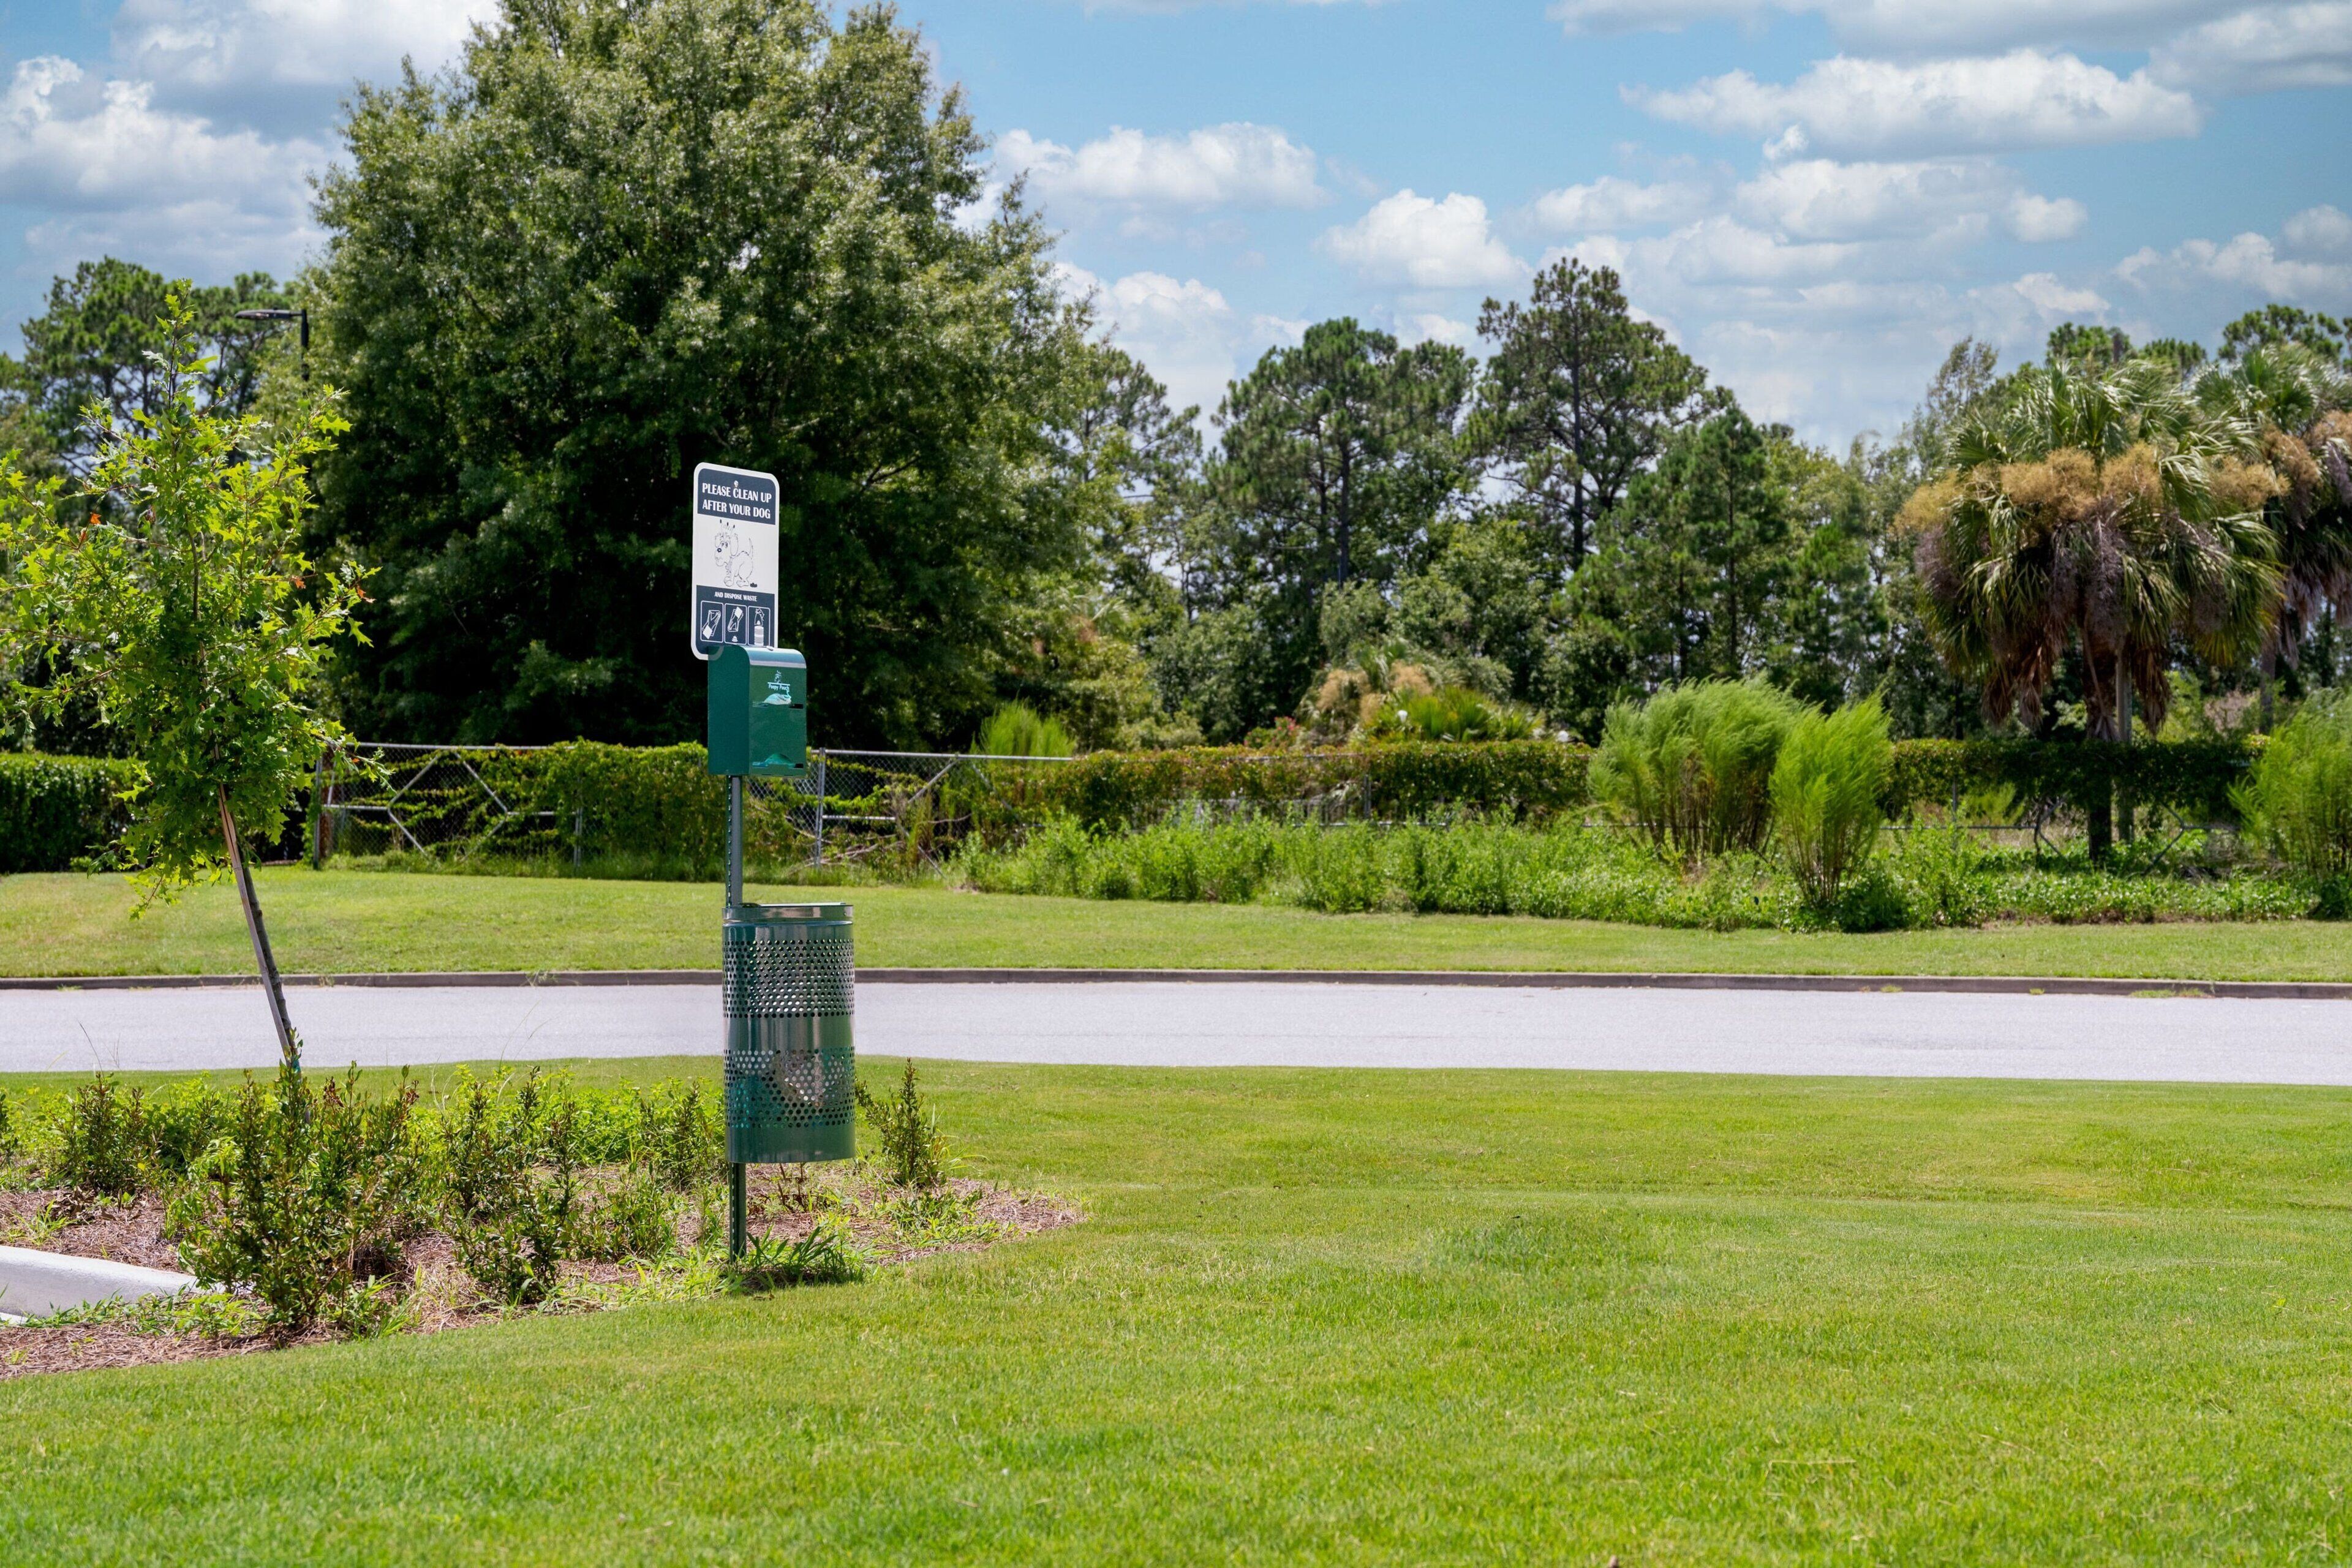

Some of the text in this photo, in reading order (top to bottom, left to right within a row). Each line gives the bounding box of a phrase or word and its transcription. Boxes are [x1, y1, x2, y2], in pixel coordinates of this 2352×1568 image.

[702, 483, 772, 503] PLEASE CLEAN UP
[702, 499, 771, 519] AFTER YOUR DOG
